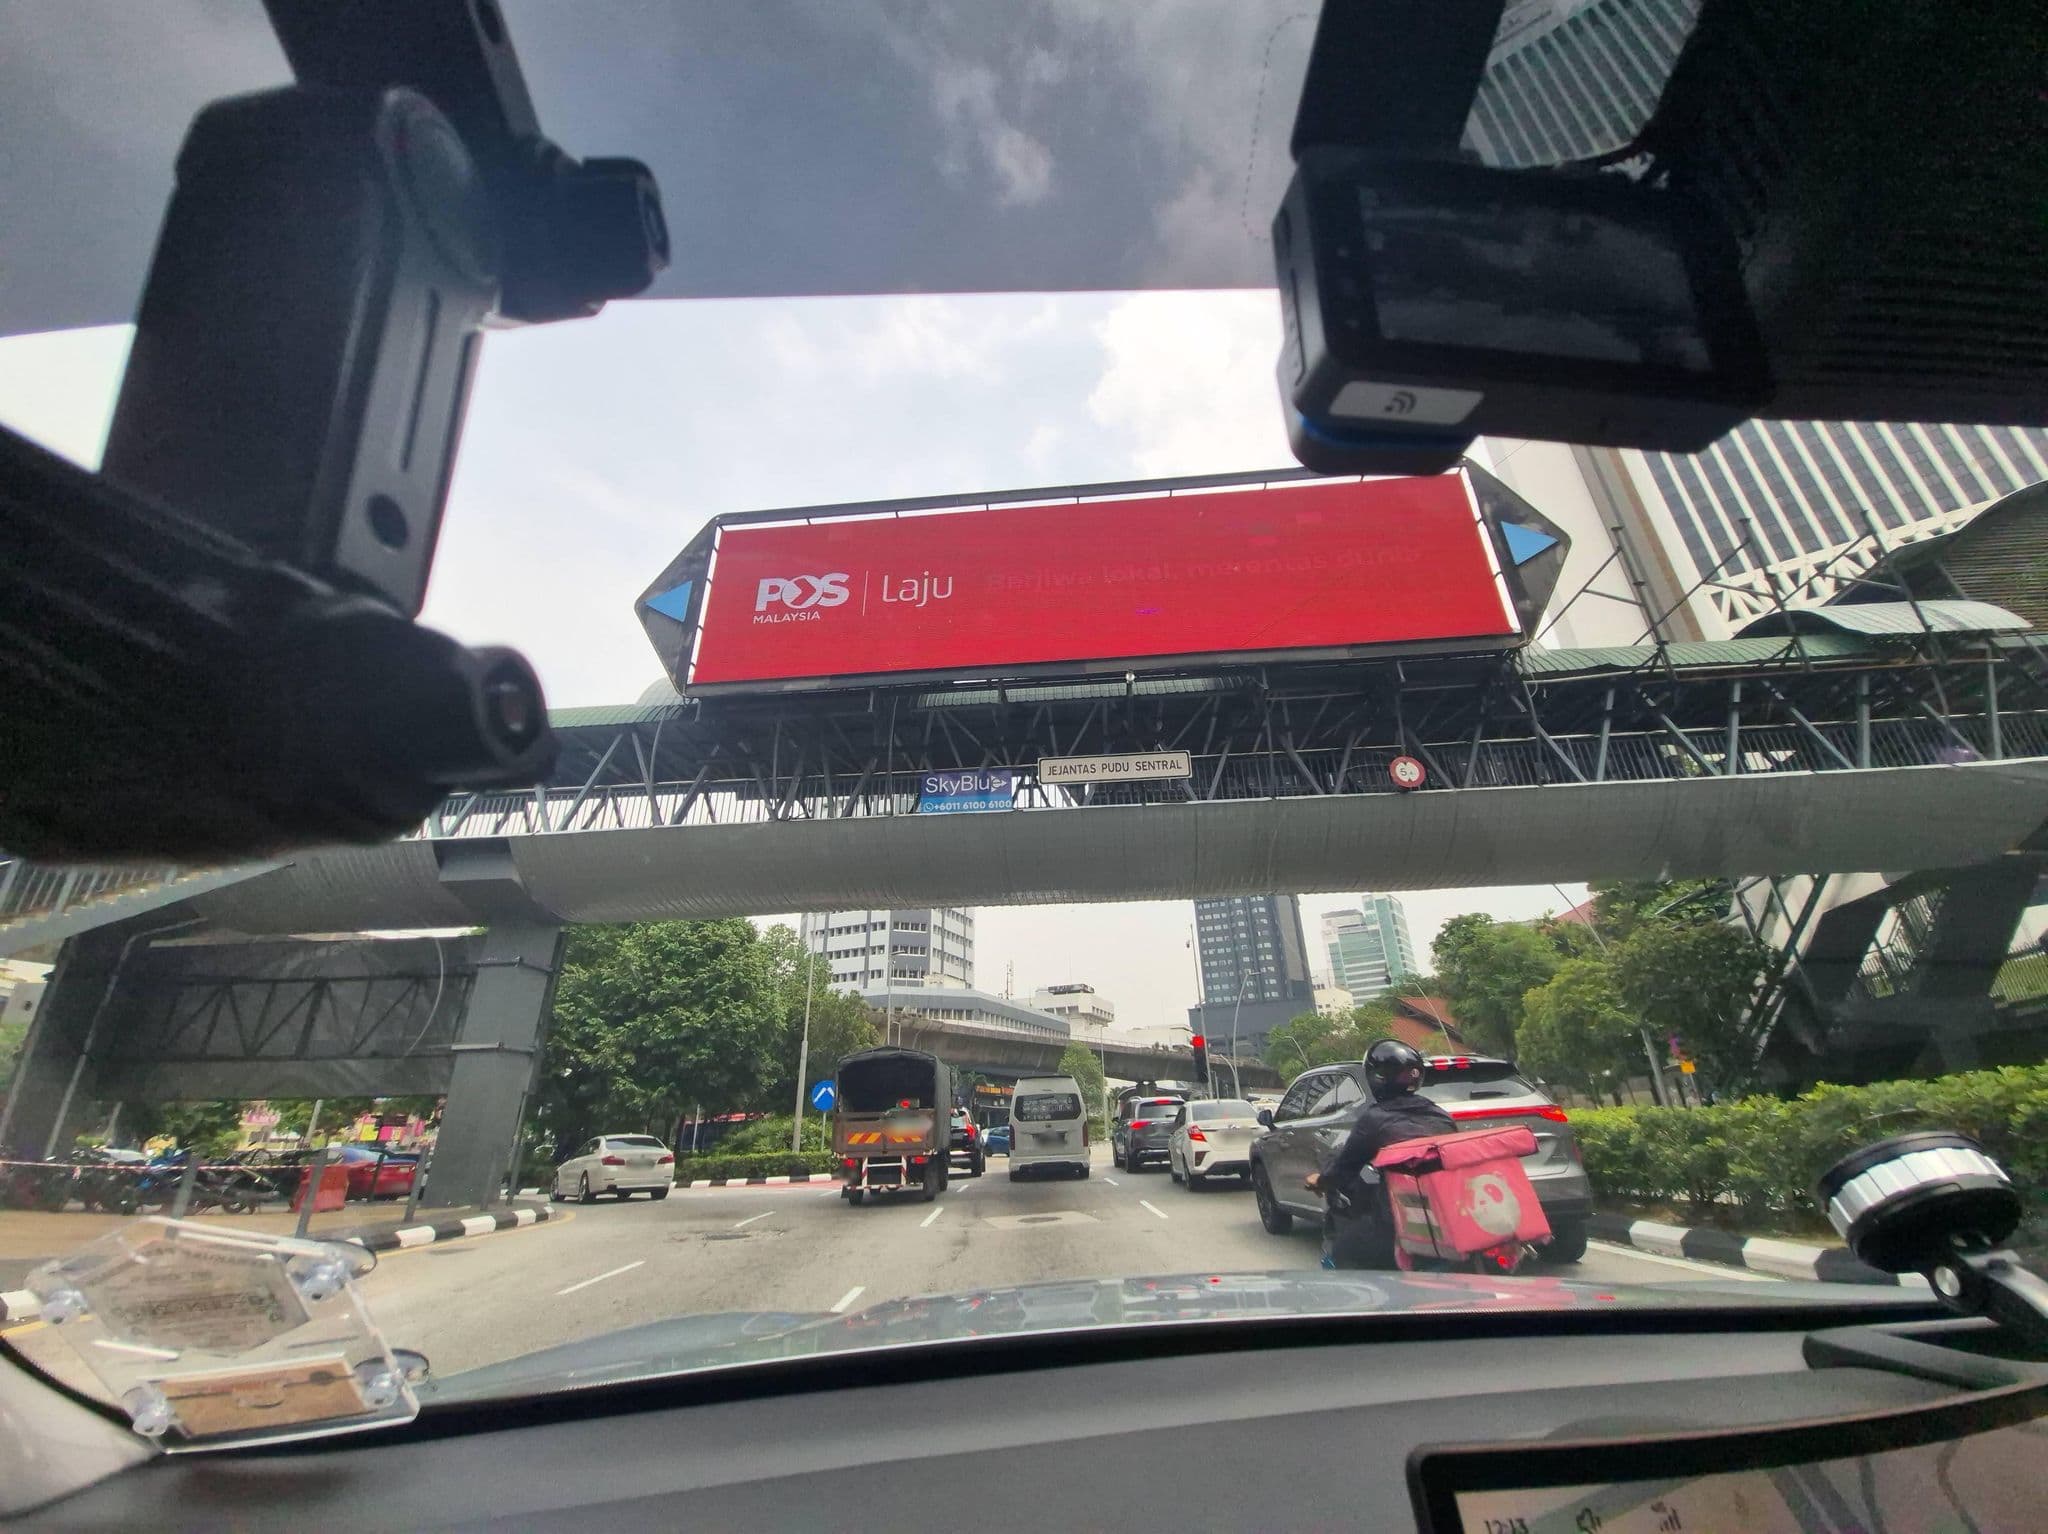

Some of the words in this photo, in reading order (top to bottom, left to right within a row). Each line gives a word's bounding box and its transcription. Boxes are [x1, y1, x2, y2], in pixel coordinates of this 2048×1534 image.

[754, 573, 850, 612] POS
[881, 571, 953, 607] Laju
[753, 611, 821, 625] MALAYSIA
[1047, 763, 1097, 776] JEJANTAS
[1101, 761, 1130, 774] PUDU
[1135, 759, 1183, 772] SENTRAL
[963, 801, 986, 810] 6100
[988, 800, 1011, 809] 6100
